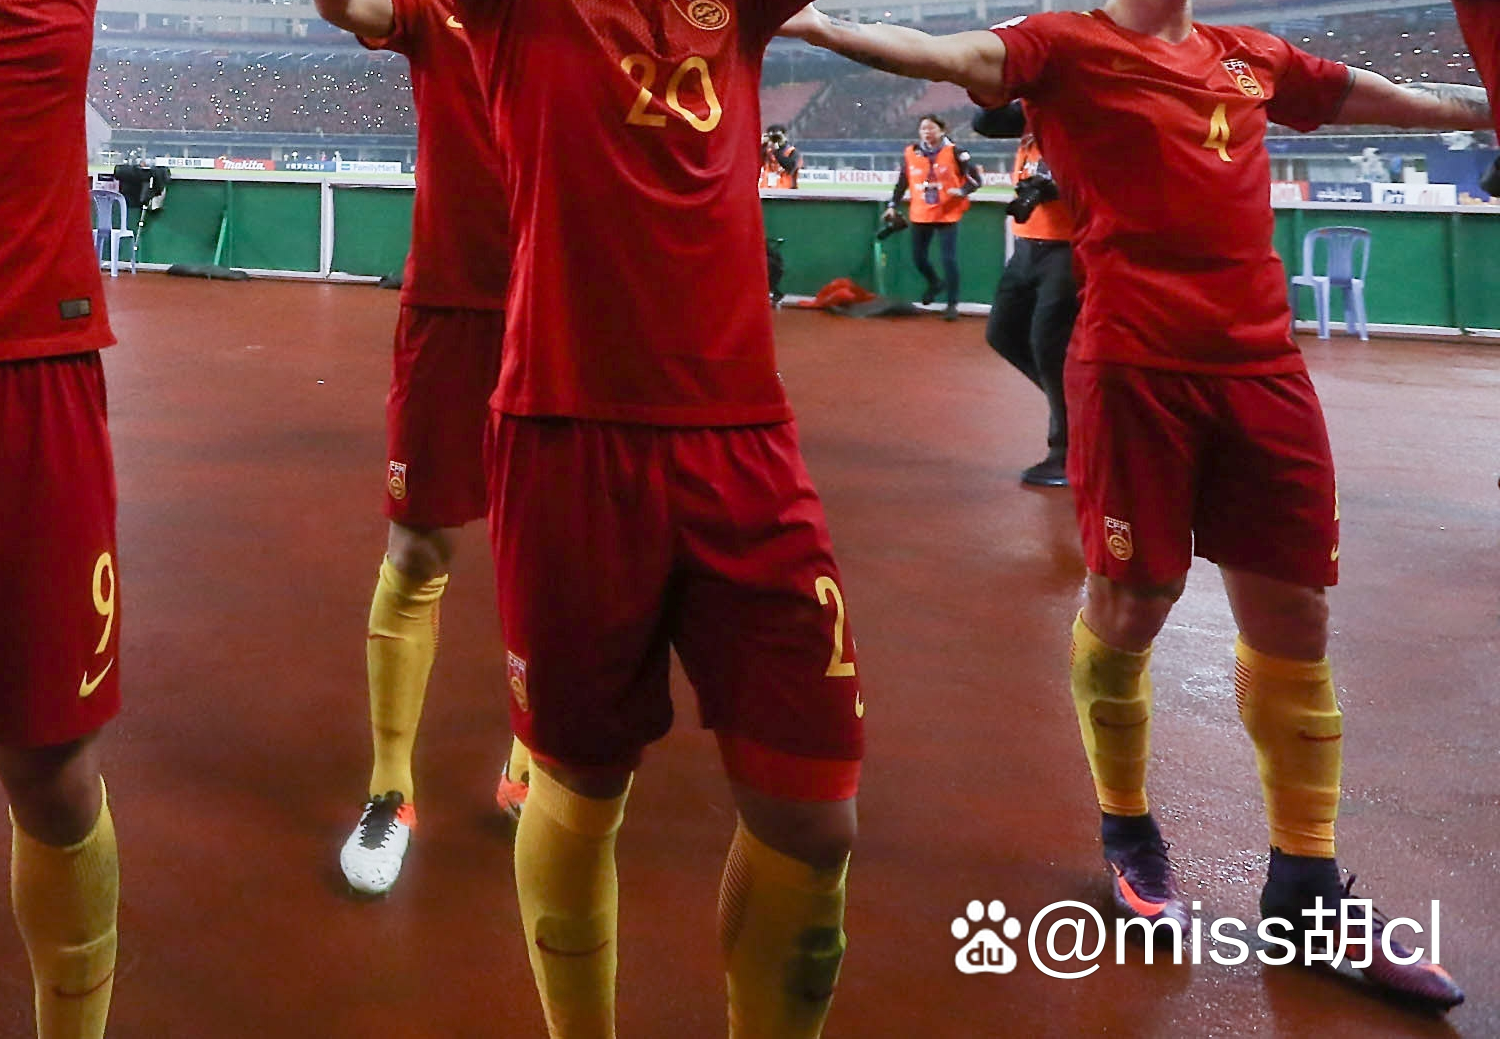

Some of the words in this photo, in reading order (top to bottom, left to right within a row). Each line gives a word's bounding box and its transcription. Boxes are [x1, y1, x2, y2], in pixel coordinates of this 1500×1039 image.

[619, 55, 722, 133] 20
[1203, 104, 1232, 162] 4
[353, 164, 397, 173] FamilyMart
[839, 171, 882, 182] KIRIN
[92, 551, 115, 654] 9
[815, 576, 857, 677] 2
